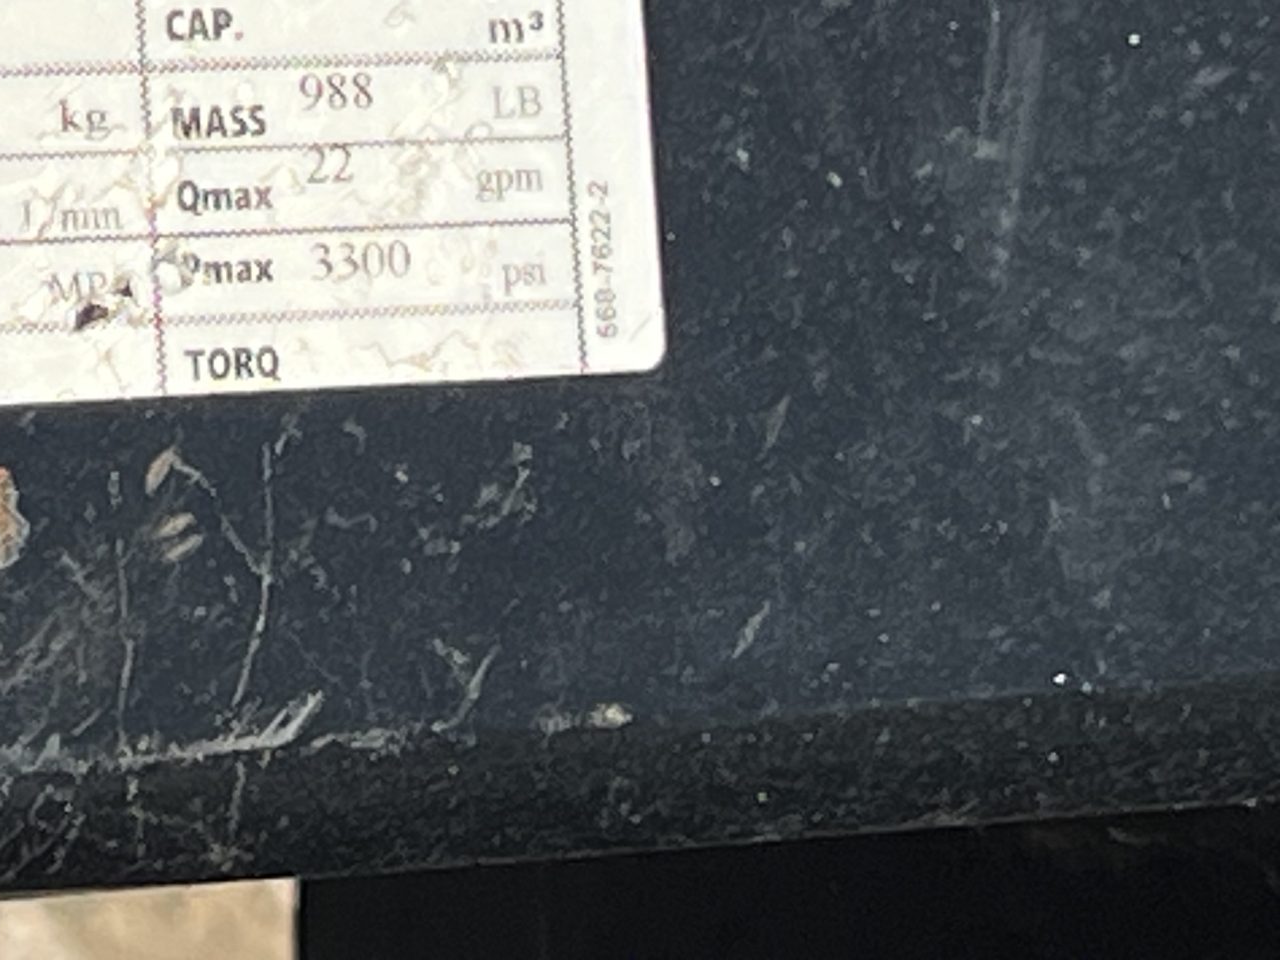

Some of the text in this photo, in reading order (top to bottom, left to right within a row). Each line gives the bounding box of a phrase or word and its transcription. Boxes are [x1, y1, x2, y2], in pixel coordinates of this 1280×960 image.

[299, 73, 374, 111] 988
[492, 85, 543, 120] LB
[60, 100, 108, 141] kg
[171, 105, 266, 138] MASS
[306, 145, 354, 184] 22
[177, 178, 273, 213] Qmax
[475, 167, 544, 200] gpm
[310, 240, 412, 281] 3300
[502, 256, 546, 295] psi
[51, 270, 132, 304] MP
[185, 347, 282, 382] TORQ
